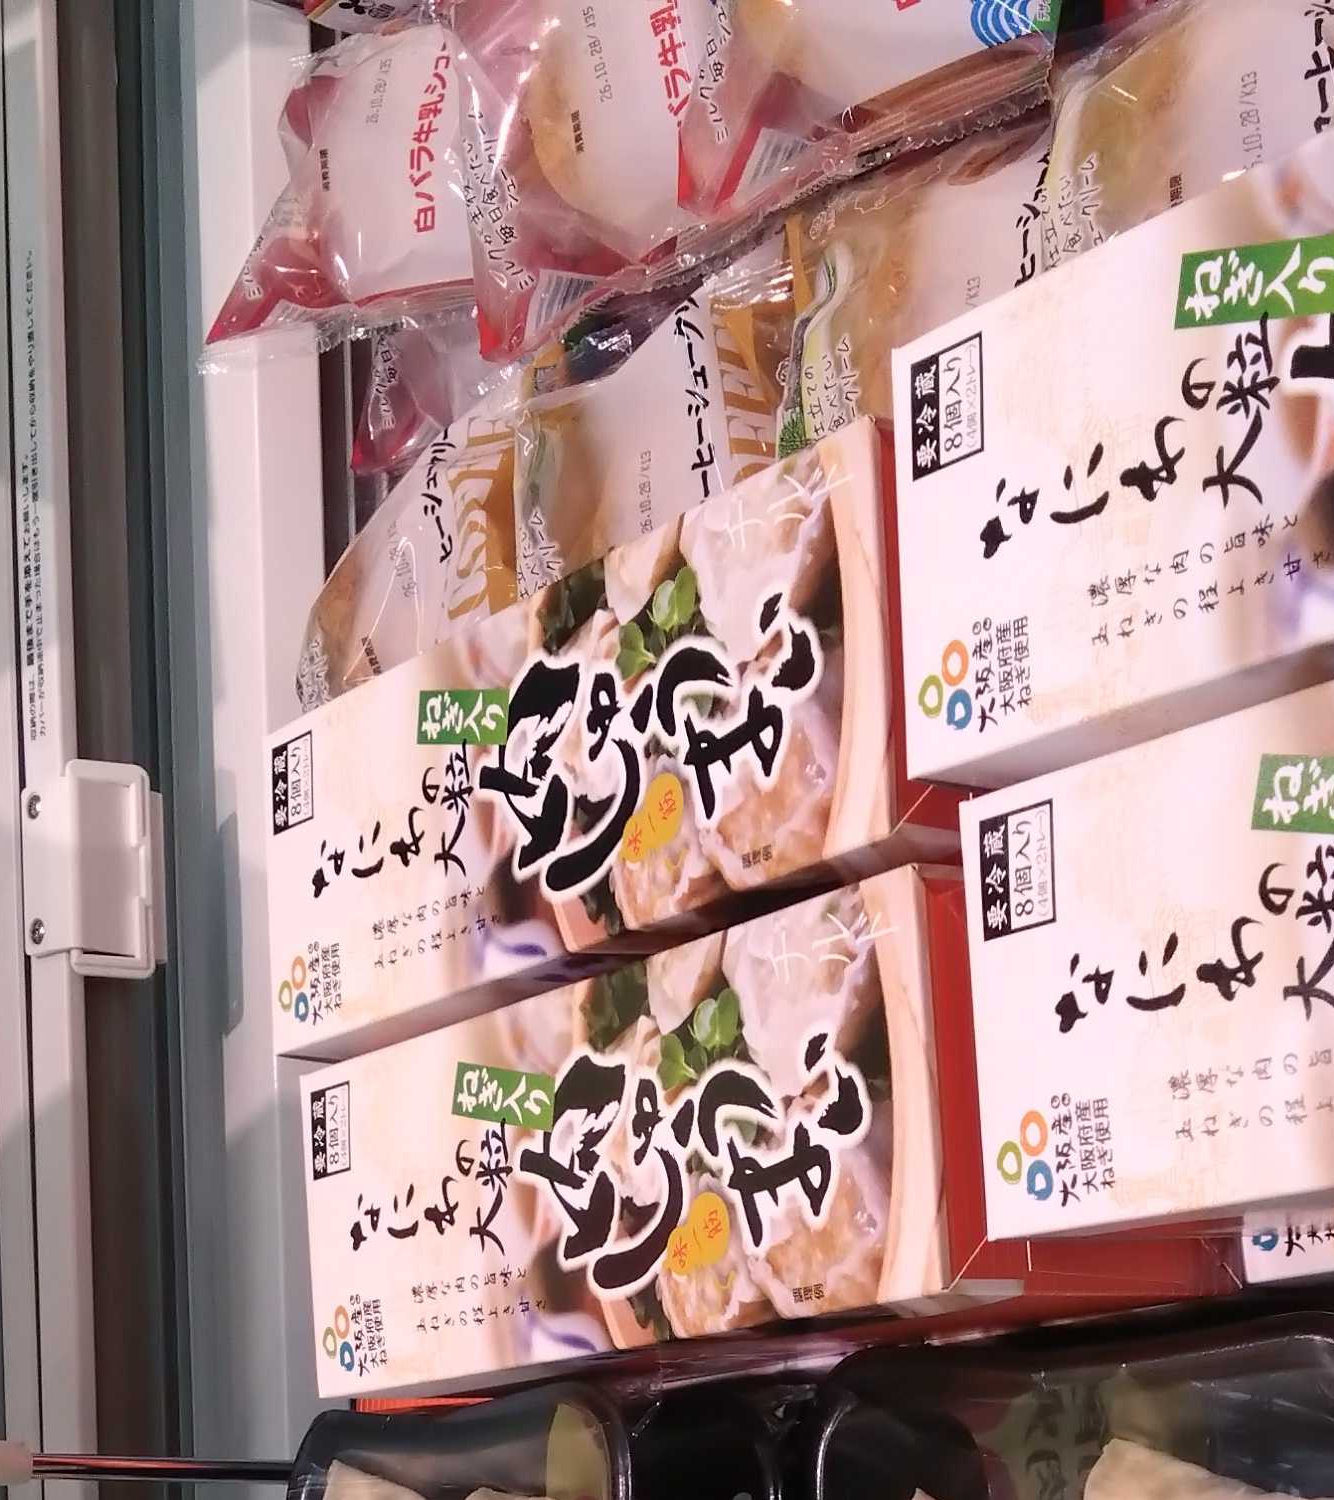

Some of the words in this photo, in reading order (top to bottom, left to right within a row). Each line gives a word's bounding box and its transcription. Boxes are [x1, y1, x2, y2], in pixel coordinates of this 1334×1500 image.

[915, 363, 938, 468] 要冷蔵
[942, 355, 965, 453] 8個入り
[717, 462, 854, 551] チルド
[997, 619, 1016, 715] 大阪府産
[1013, 616, 1032, 708] ねぎ使用
[421, 692, 505, 743] ねぎ入り
[622, 787, 679, 858] 味一筋
[1012, 819, 1035, 917] 8個入り
[983, 822, 1009, 931] 要冷蔵
[761, 910, 901, 984] チルド
[457, 1068, 551, 1122] ねぎ入り
[1075, 1099, 1098, 1194] 大阪府産
[1093, 1097, 1116, 1189] ねぎ使用
[670, 1207, 722, 1268] 味一筋
